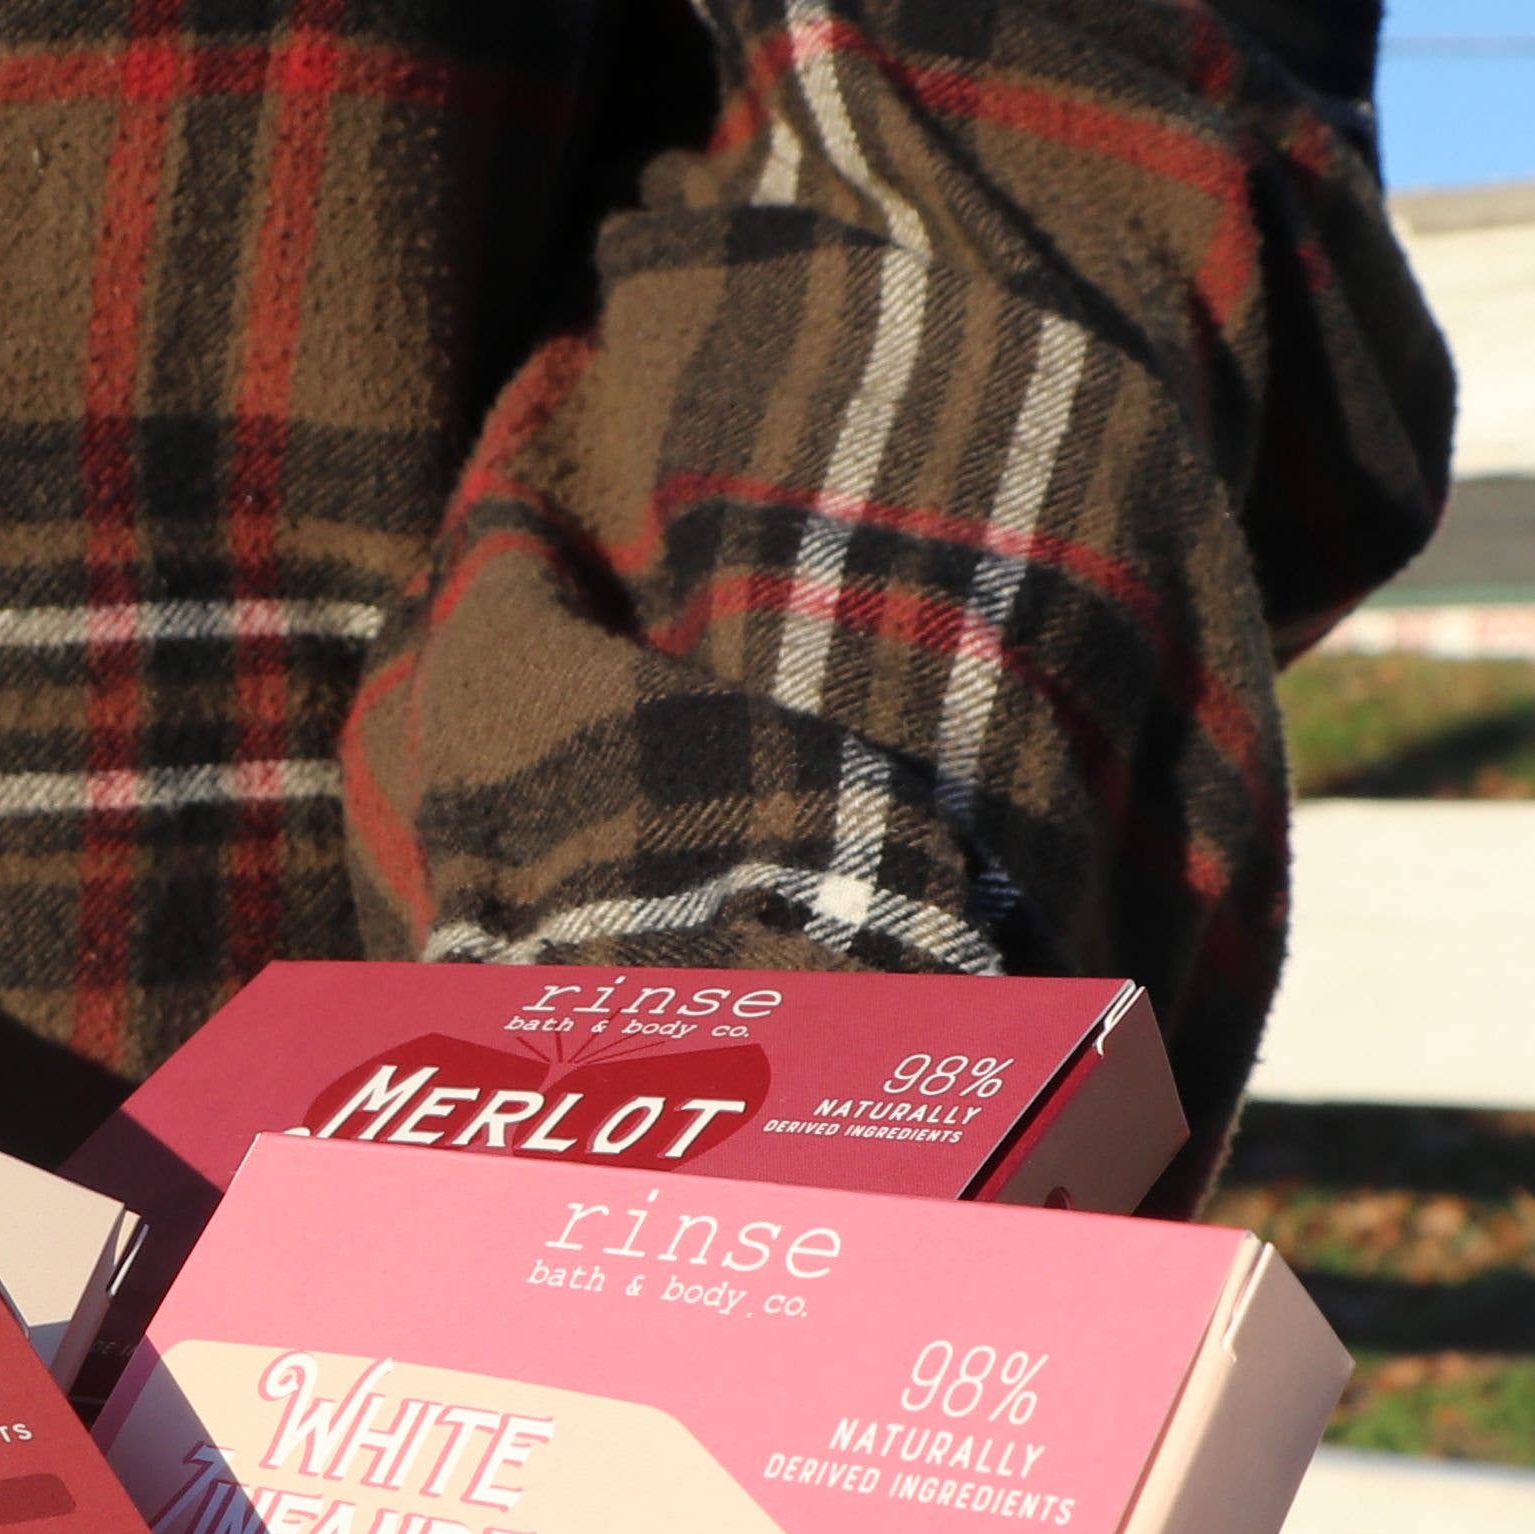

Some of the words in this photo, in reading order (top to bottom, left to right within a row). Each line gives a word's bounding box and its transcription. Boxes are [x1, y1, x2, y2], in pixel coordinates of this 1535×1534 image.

[522, 976, 782, 1018] rinse
[504, 1016, 574, 1032] bath
[621, 1019, 698, 1039] body
[711, 1025, 749, 1037] co.
[883, 1054, 1014, 1098] 98%
[283, 1064, 746, 1158] MERLOT
[763, 1120, 840, 1135] DERIVED
[844, 1125, 963, 1143] INGREDIENTS
[813, 1099, 982, 1124] NATURALLY
[545, 1189, 842, 1279] rinse
[526, 1258, 606, 1293] bath
[763, 1293, 808, 1318] co.
[900, 1340, 1049, 1425] 98%
[259, 1350, 555, 1511] WHITE
[829, 1418, 1045, 1478] NATURALLY
[764, 1453, 881, 1494] DERIVED
[889, 1472, 1075, 1525] INGREDIENTS
